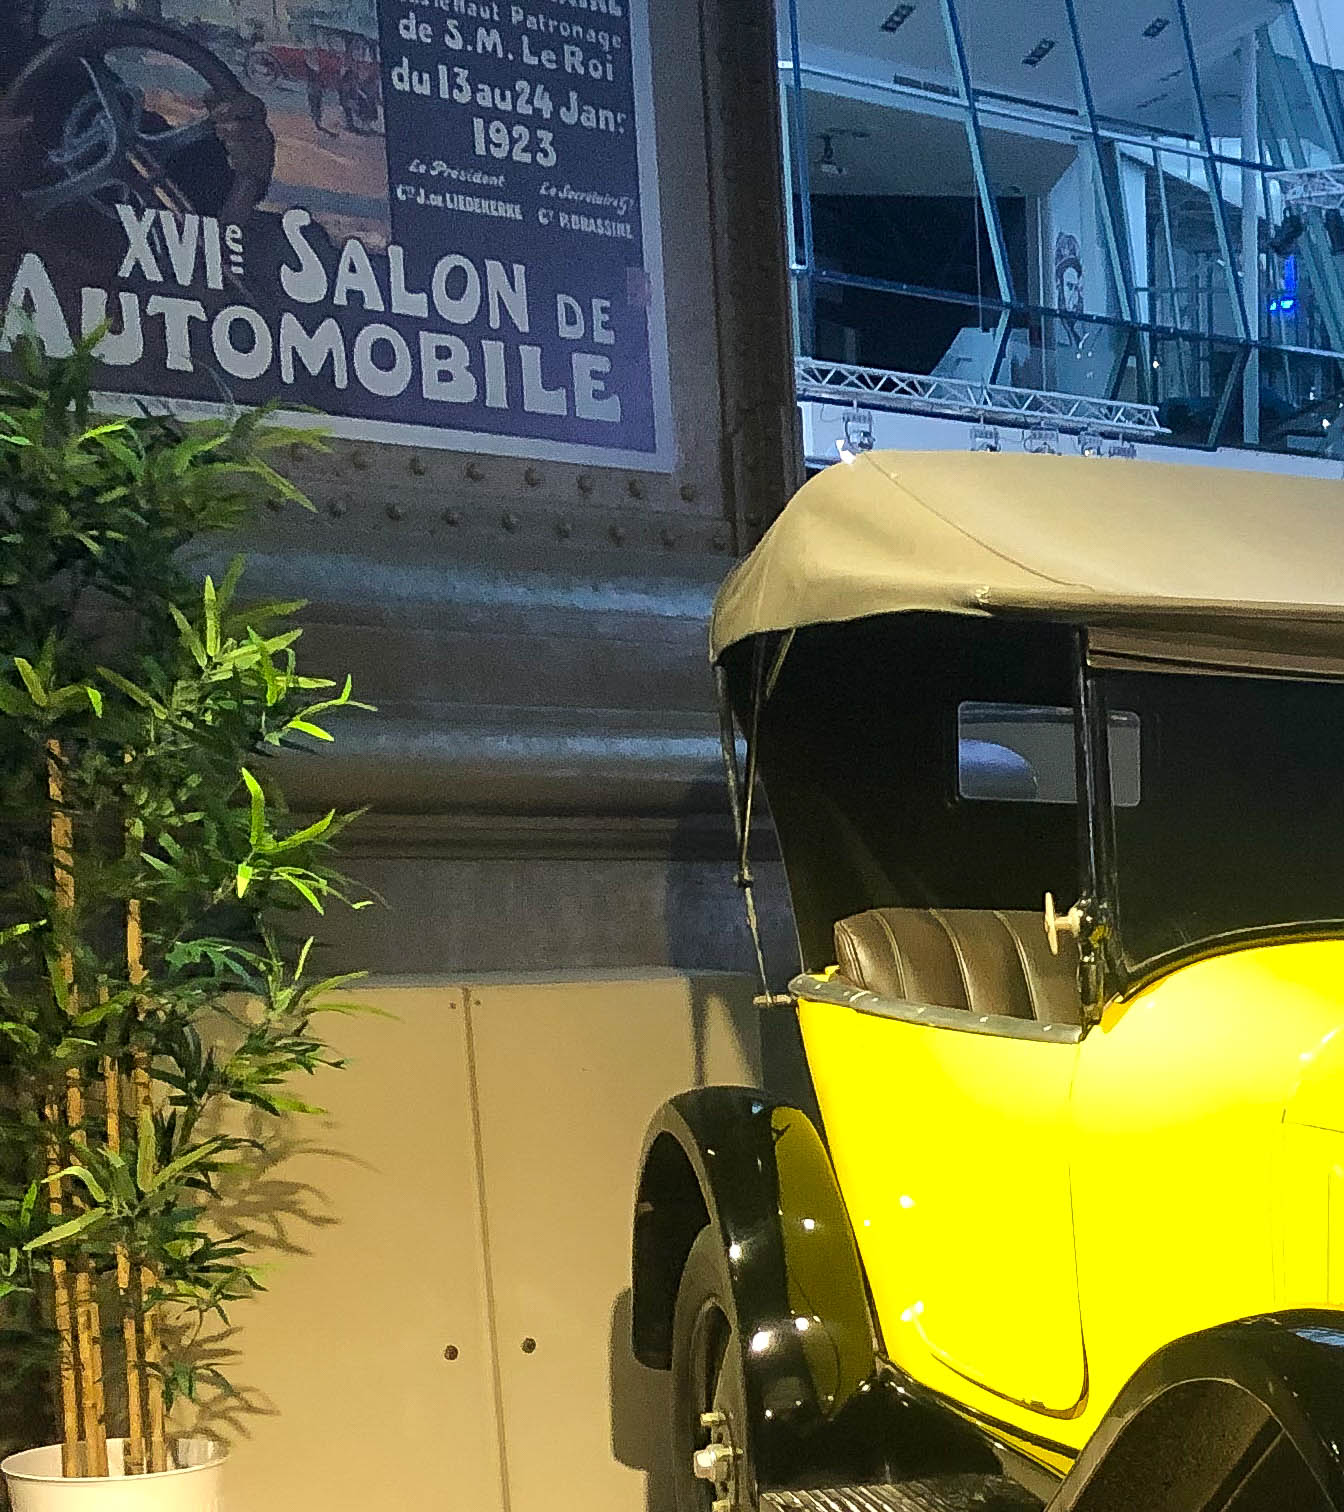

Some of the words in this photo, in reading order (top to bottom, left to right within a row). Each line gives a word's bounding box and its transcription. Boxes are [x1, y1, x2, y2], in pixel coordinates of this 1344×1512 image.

[399, 10, 434, 43] de
[444, 18, 514, 60] S.M.
[563, 43, 614, 81] Roi
[511, 5, 622, 52] Patronage
[390, 56, 431, 96] du
[437, 64, 473, 104] 13
[475, 83, 513, 112] au
[515, 80, 553, 119] 24
[472, 117, 557, 168] 1923
[280, 208, 530, 335] SALON
[557, 293, 616, 346] DE
[0, 253, 622, 423] AUTOMOBILE
